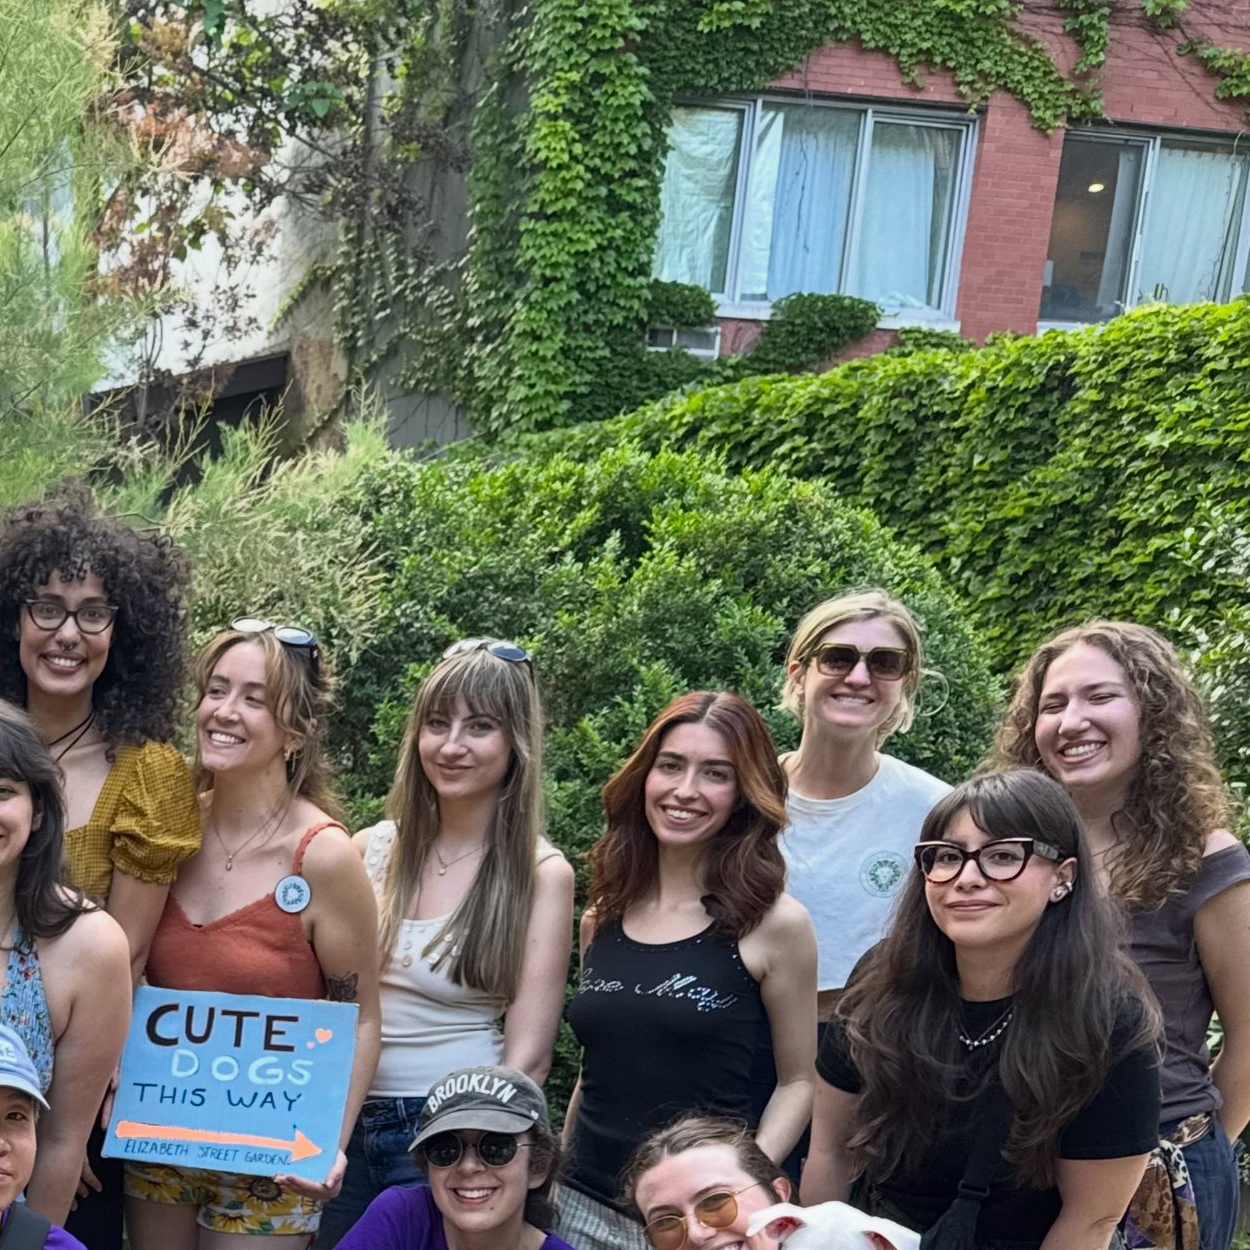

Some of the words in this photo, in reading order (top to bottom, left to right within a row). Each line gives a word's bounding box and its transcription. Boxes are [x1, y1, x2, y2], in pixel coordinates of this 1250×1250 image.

[146, 1003, 299, 1052] CUTE
[171, 1049, 313, 1085] DOGS
[133, 1082, 206, 1106] THIS
[227, 1089, 302, 1111] WAY
[427, 1073, 517, 1113] BROOKLYN
[124, 1139, 188, 1156] ELIZABETH
[198, 1146, 239, 1162] STREET
